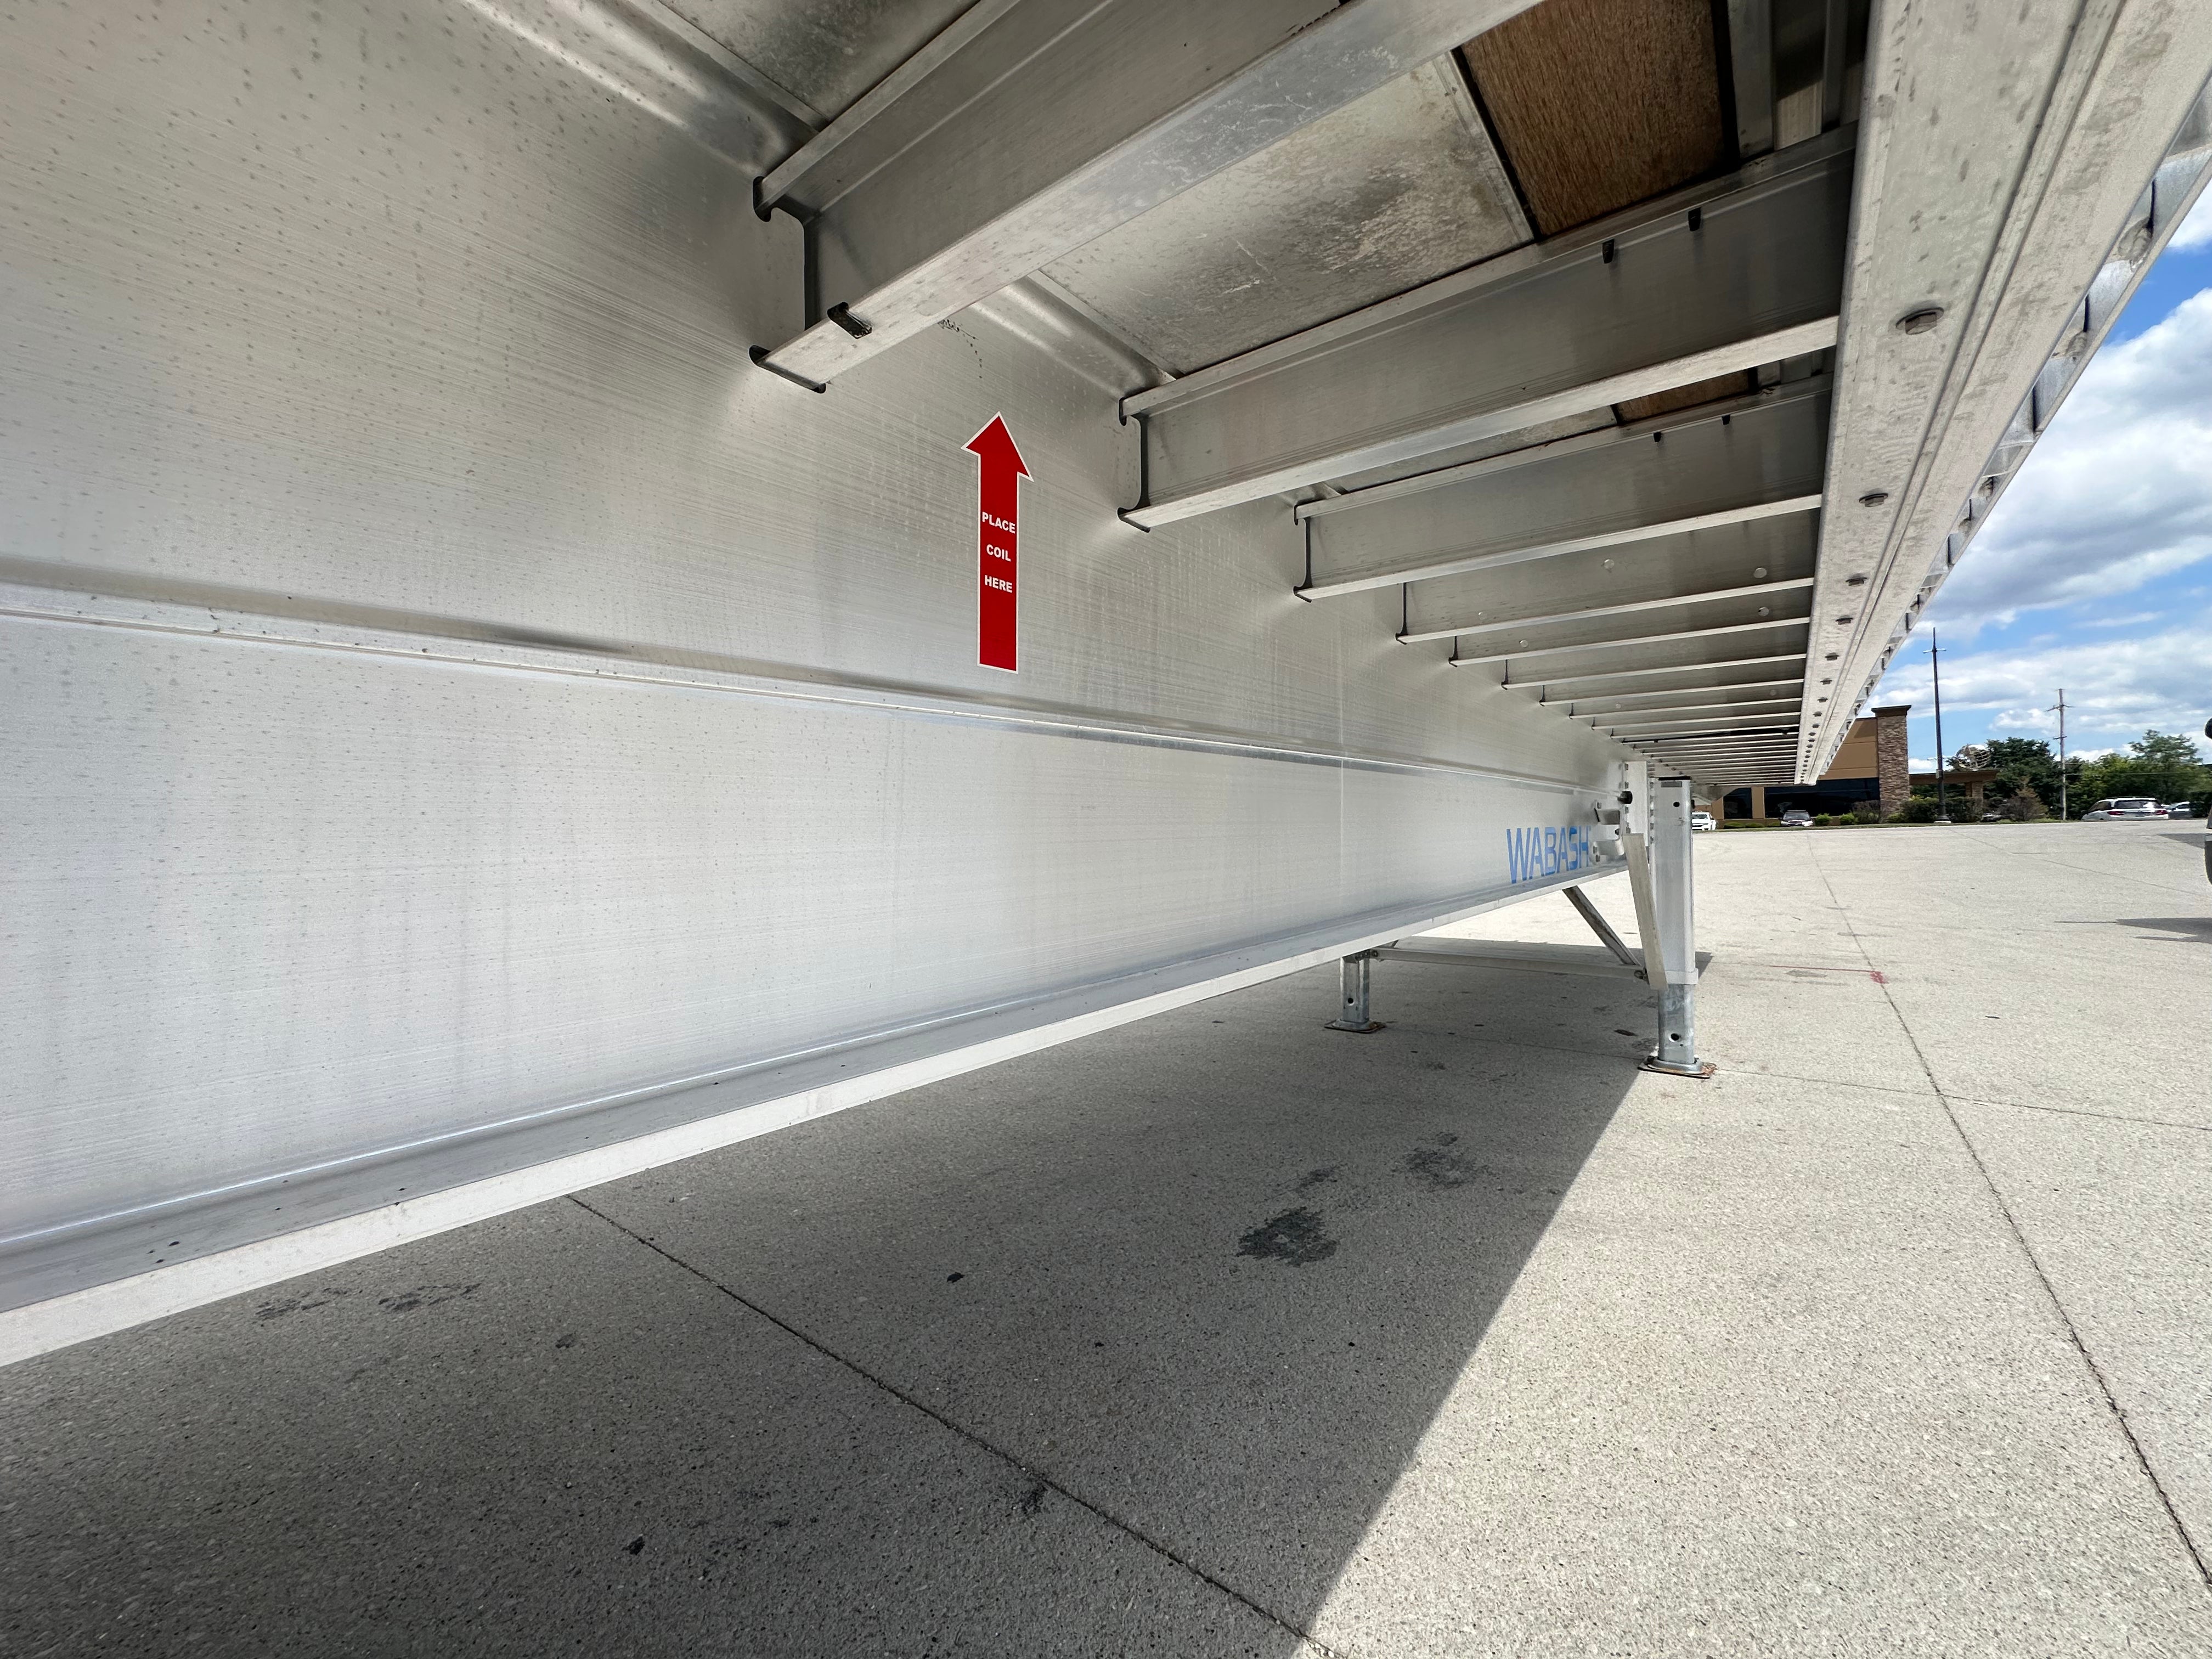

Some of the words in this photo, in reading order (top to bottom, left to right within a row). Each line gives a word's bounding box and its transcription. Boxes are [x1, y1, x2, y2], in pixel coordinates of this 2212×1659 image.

[982, 511, 1015, 534] PLACE
[986, 544, 1011, 562] COIL
[984, 574, 1013, 593] HERE
[1506, 825, 1589, 884] WABASH
